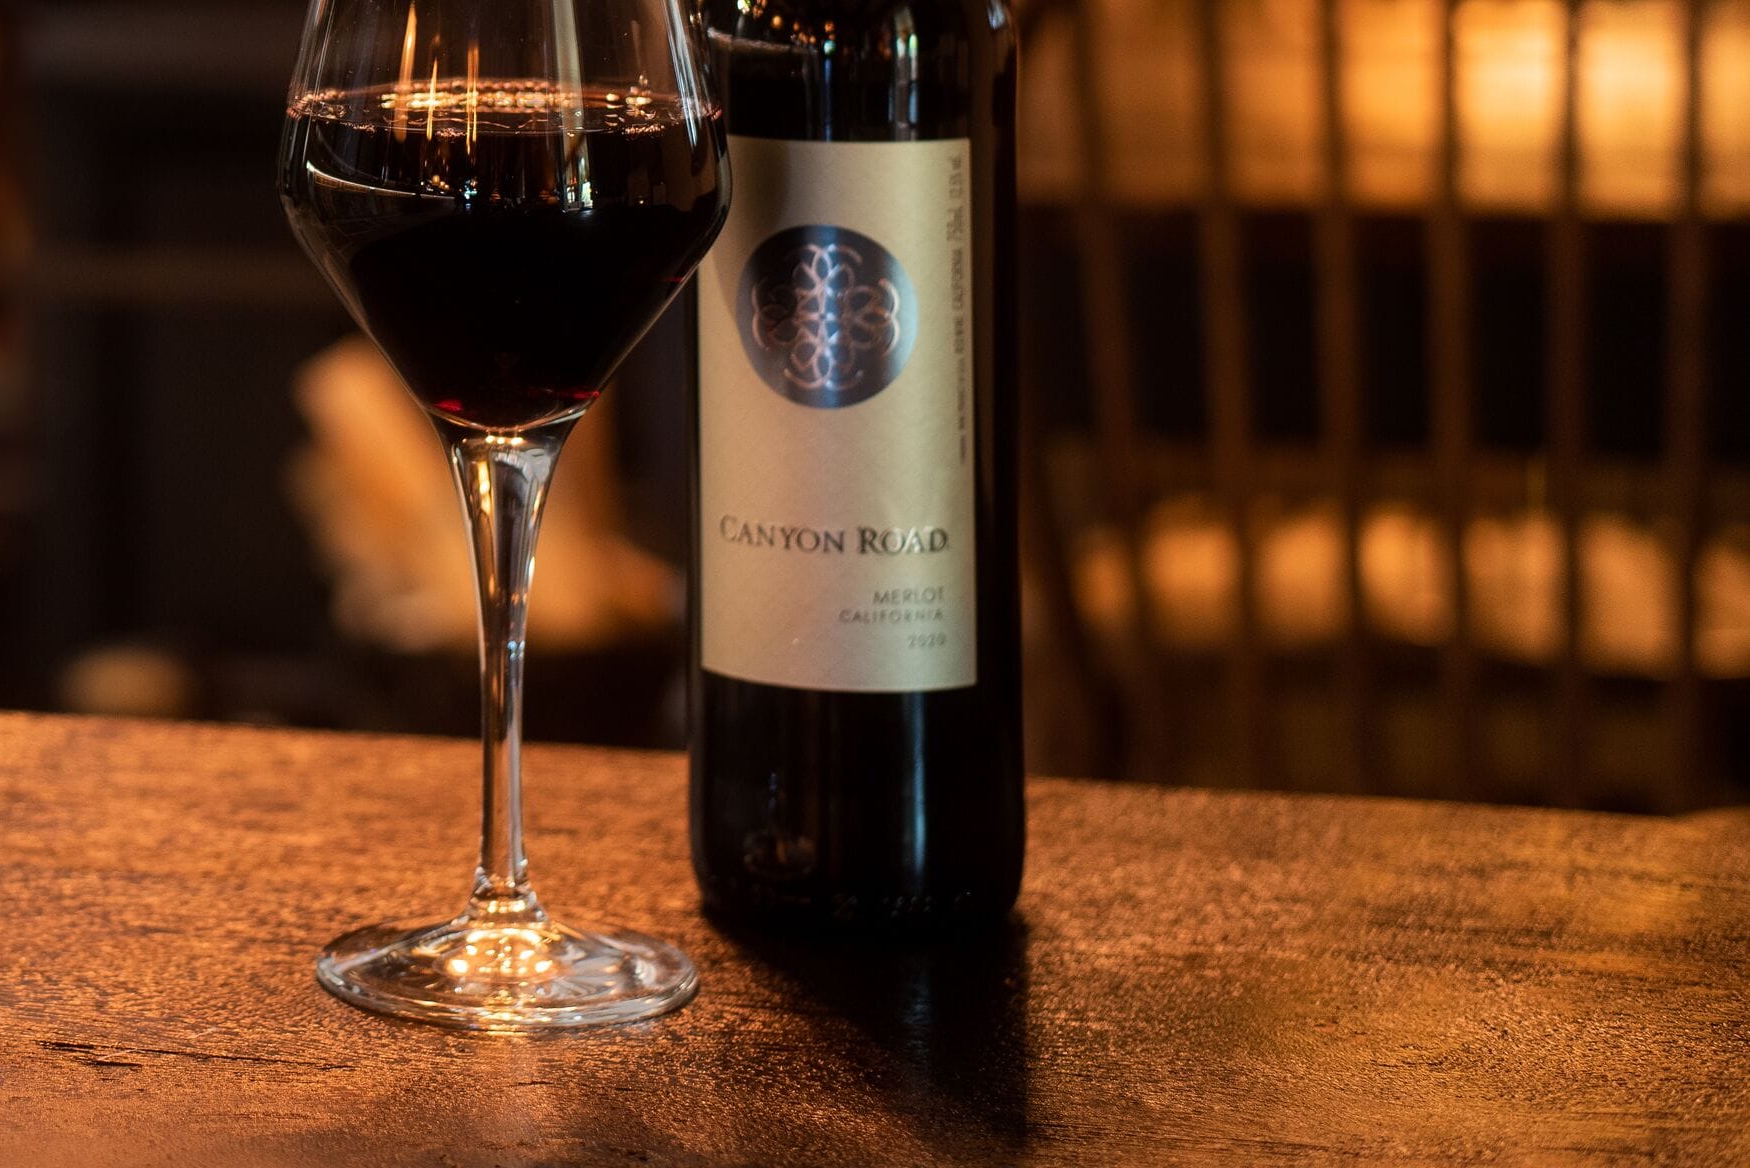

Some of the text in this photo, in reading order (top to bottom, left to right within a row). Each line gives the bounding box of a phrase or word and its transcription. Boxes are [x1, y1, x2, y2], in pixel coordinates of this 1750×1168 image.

[719, 514, 949, 555] CANYON ROAD
[872, 586, 945, 605] MERLOT
[839, 608, 944, 625] CALIFORNIA
